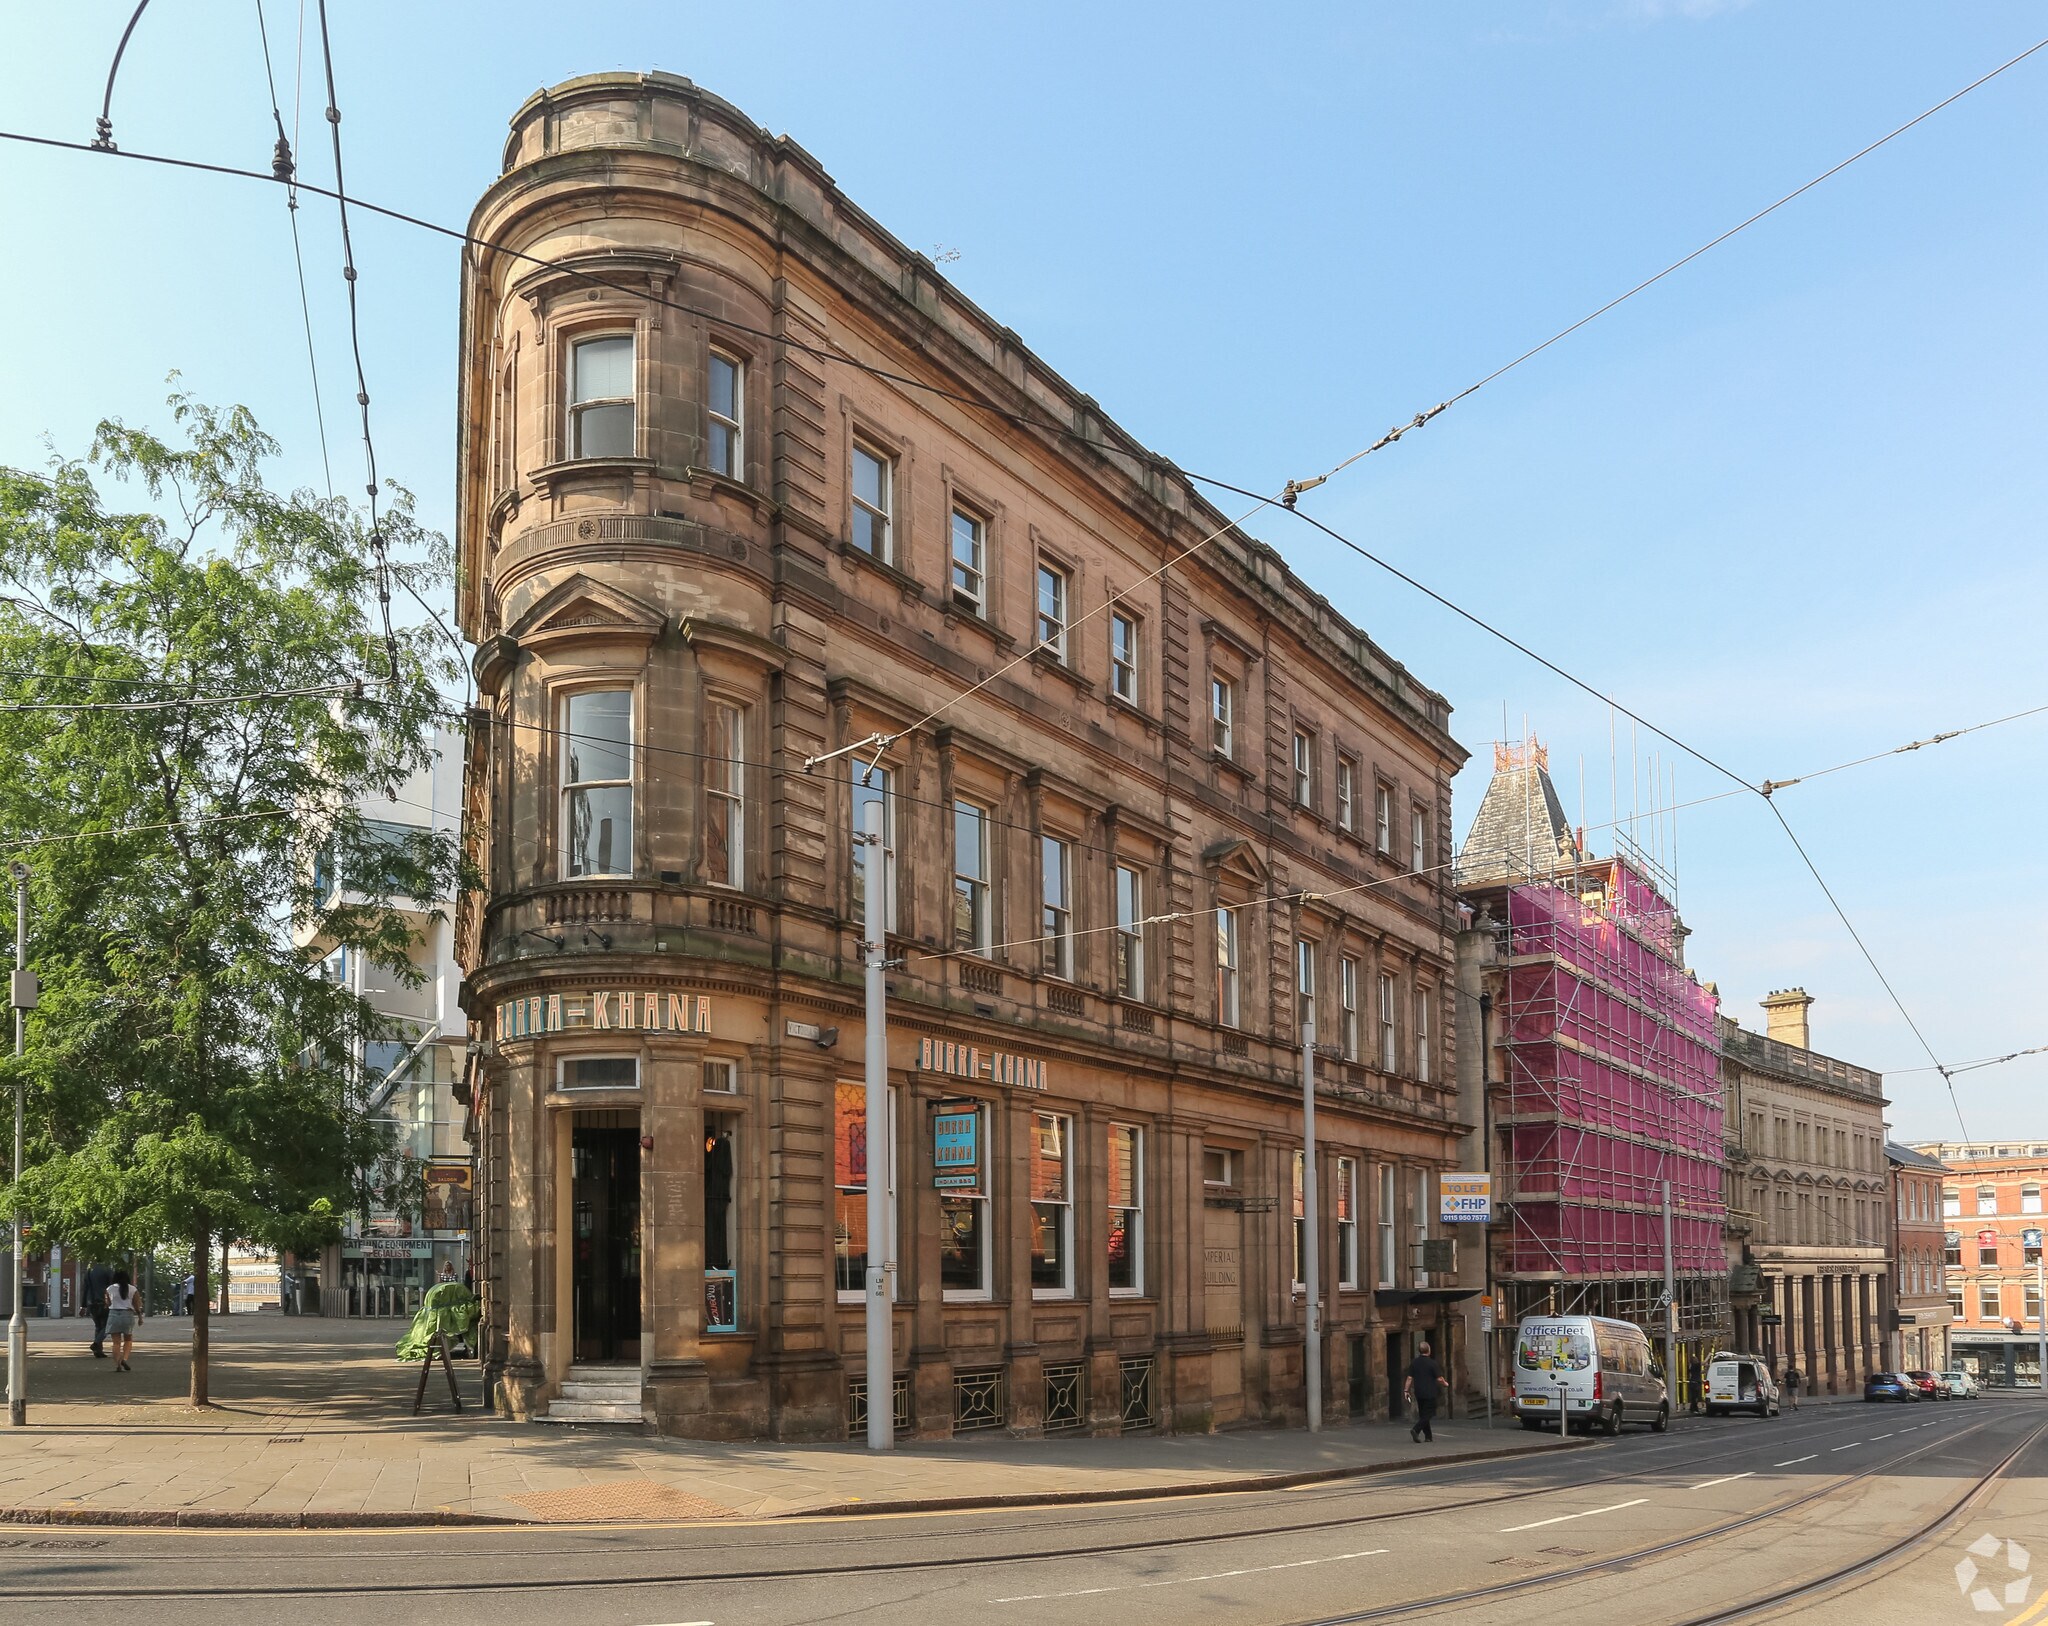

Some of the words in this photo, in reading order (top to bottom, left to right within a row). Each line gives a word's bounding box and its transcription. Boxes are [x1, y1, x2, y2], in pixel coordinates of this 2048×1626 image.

[920, 1037, 1048, 1091] BURRA-KHANA
[938, 1119, 971, 1135] BURRA
[937, 1145, 972, 1162] KHANA
[1447, 1185, 1462, 1193] TO
[1464, 1185, 1484, 1193] LET
[1461, 1198, 1487, 1210] FHP
[385, 1240, 432, 1250] EQUIPMENT
[364, 1249, 412, 1258] PECIALISTS
[1661, 1294, 1672, 1302] 25
[1524, 1325, 1585, 1336] OfficeFleet
